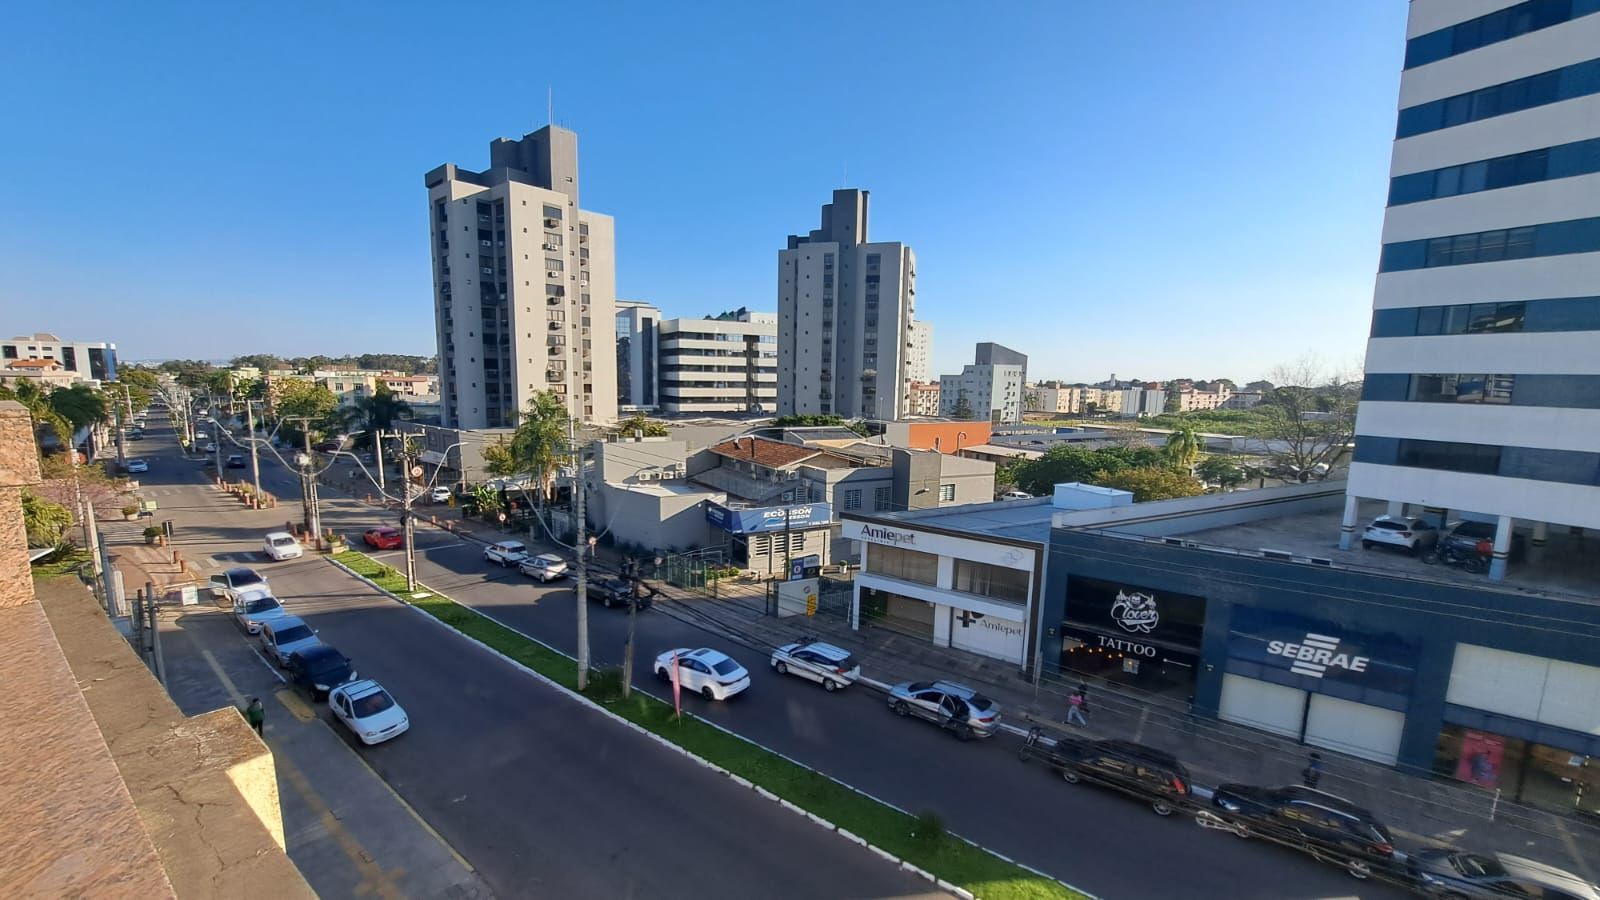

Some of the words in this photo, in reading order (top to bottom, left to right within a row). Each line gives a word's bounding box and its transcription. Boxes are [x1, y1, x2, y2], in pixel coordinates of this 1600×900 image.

[861, 524, 915, 546] Amiepet
[1110, 603, 1158, 622] Clover
[980, 619, 1022, 636] Amiepet
[1098, 635, 1156, 657] TATTOO
[1266, 640, 1370, 673] SEBRAE
